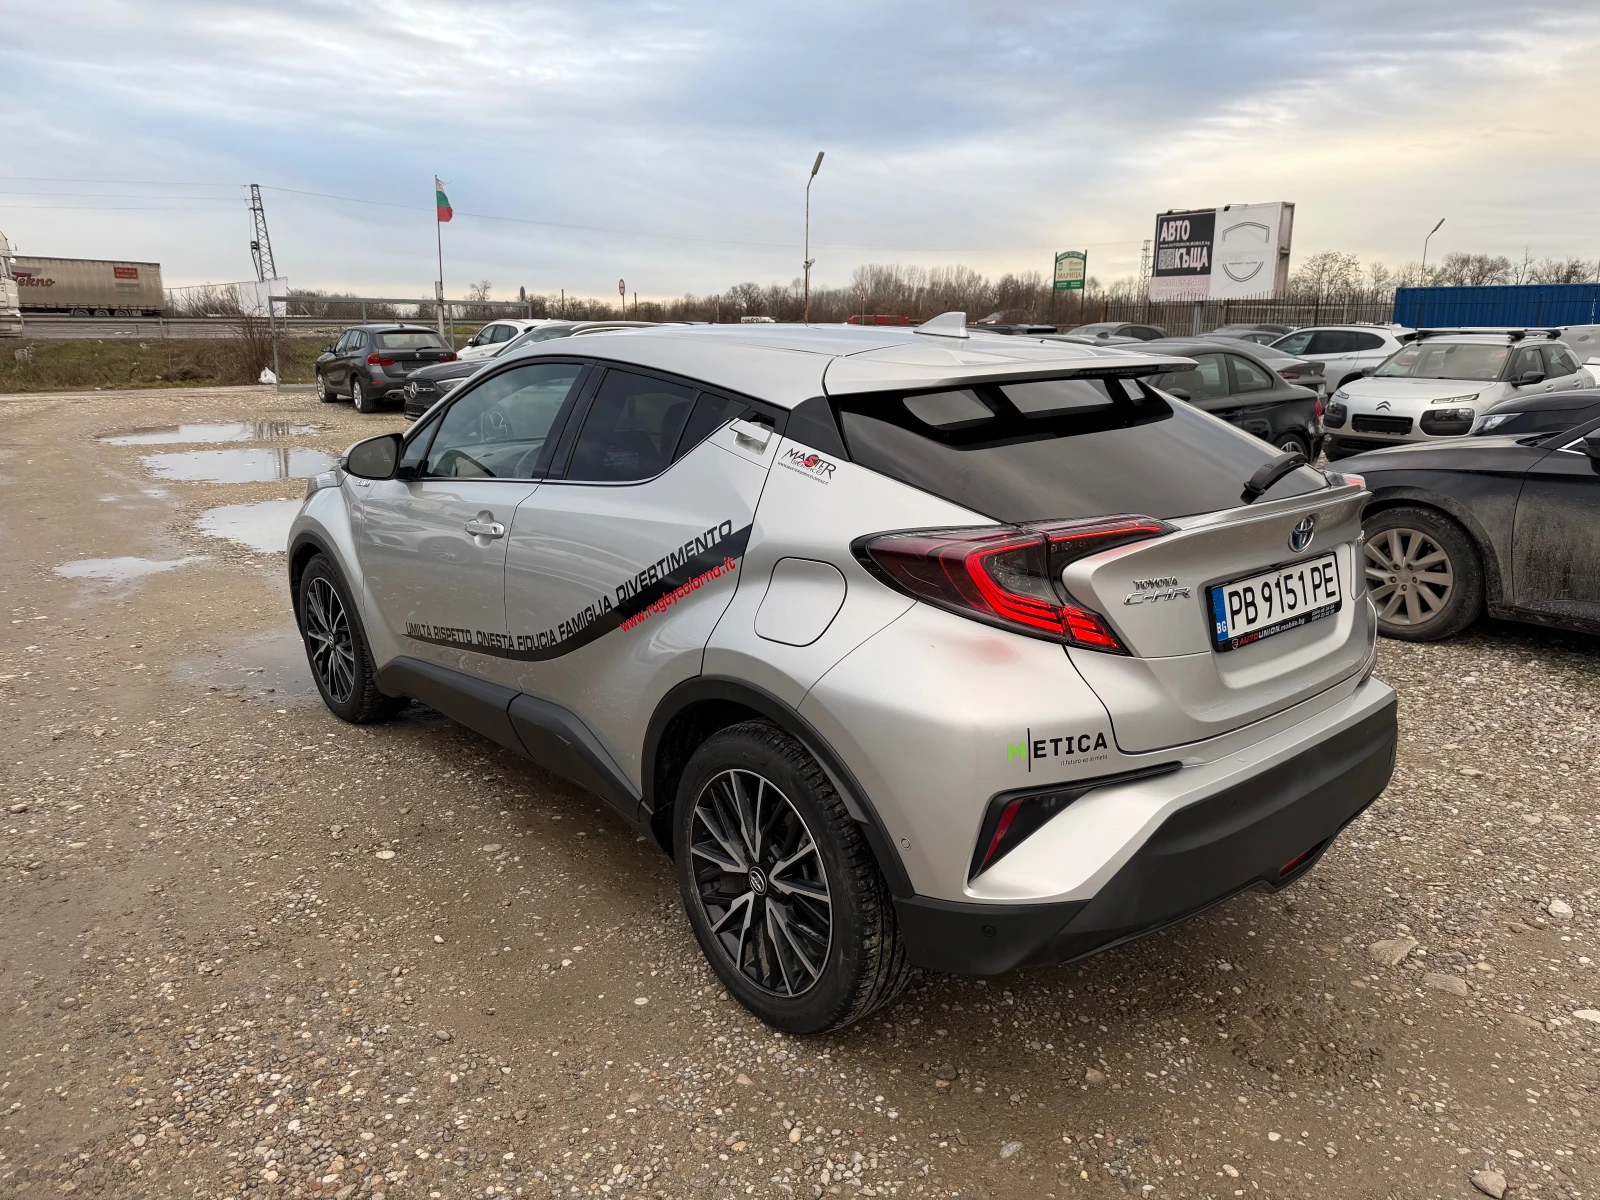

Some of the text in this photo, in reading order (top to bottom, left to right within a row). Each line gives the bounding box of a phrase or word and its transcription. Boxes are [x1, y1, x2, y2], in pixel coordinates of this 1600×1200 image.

[1160, 220, 1191, 241] АВТО
[1174, 247, 1208, 271] КЪЩА
[1057, 271, 1082, 280] МАРИЦА
[781, 448, 836, 480] MASTER
[433, 626, 473, 644] RISPETTO
[476, 631, 515, 650] ONESTÀ
[516, 629, 557, 650] FIDUCIA
[557, 595, 613, 641] FAMIGLIA
[615, 519, 732, 602] DIVERTIMENTO
[1133, 576, 1178, 590] TOYOTA
[619, 557, 736, 632] www.rugbycolorno.it
[1123, 587, 1191, 605] C-HR
[1261, 570, 1308, 619] 9151
[1216, 621, 1227, 634] BG
